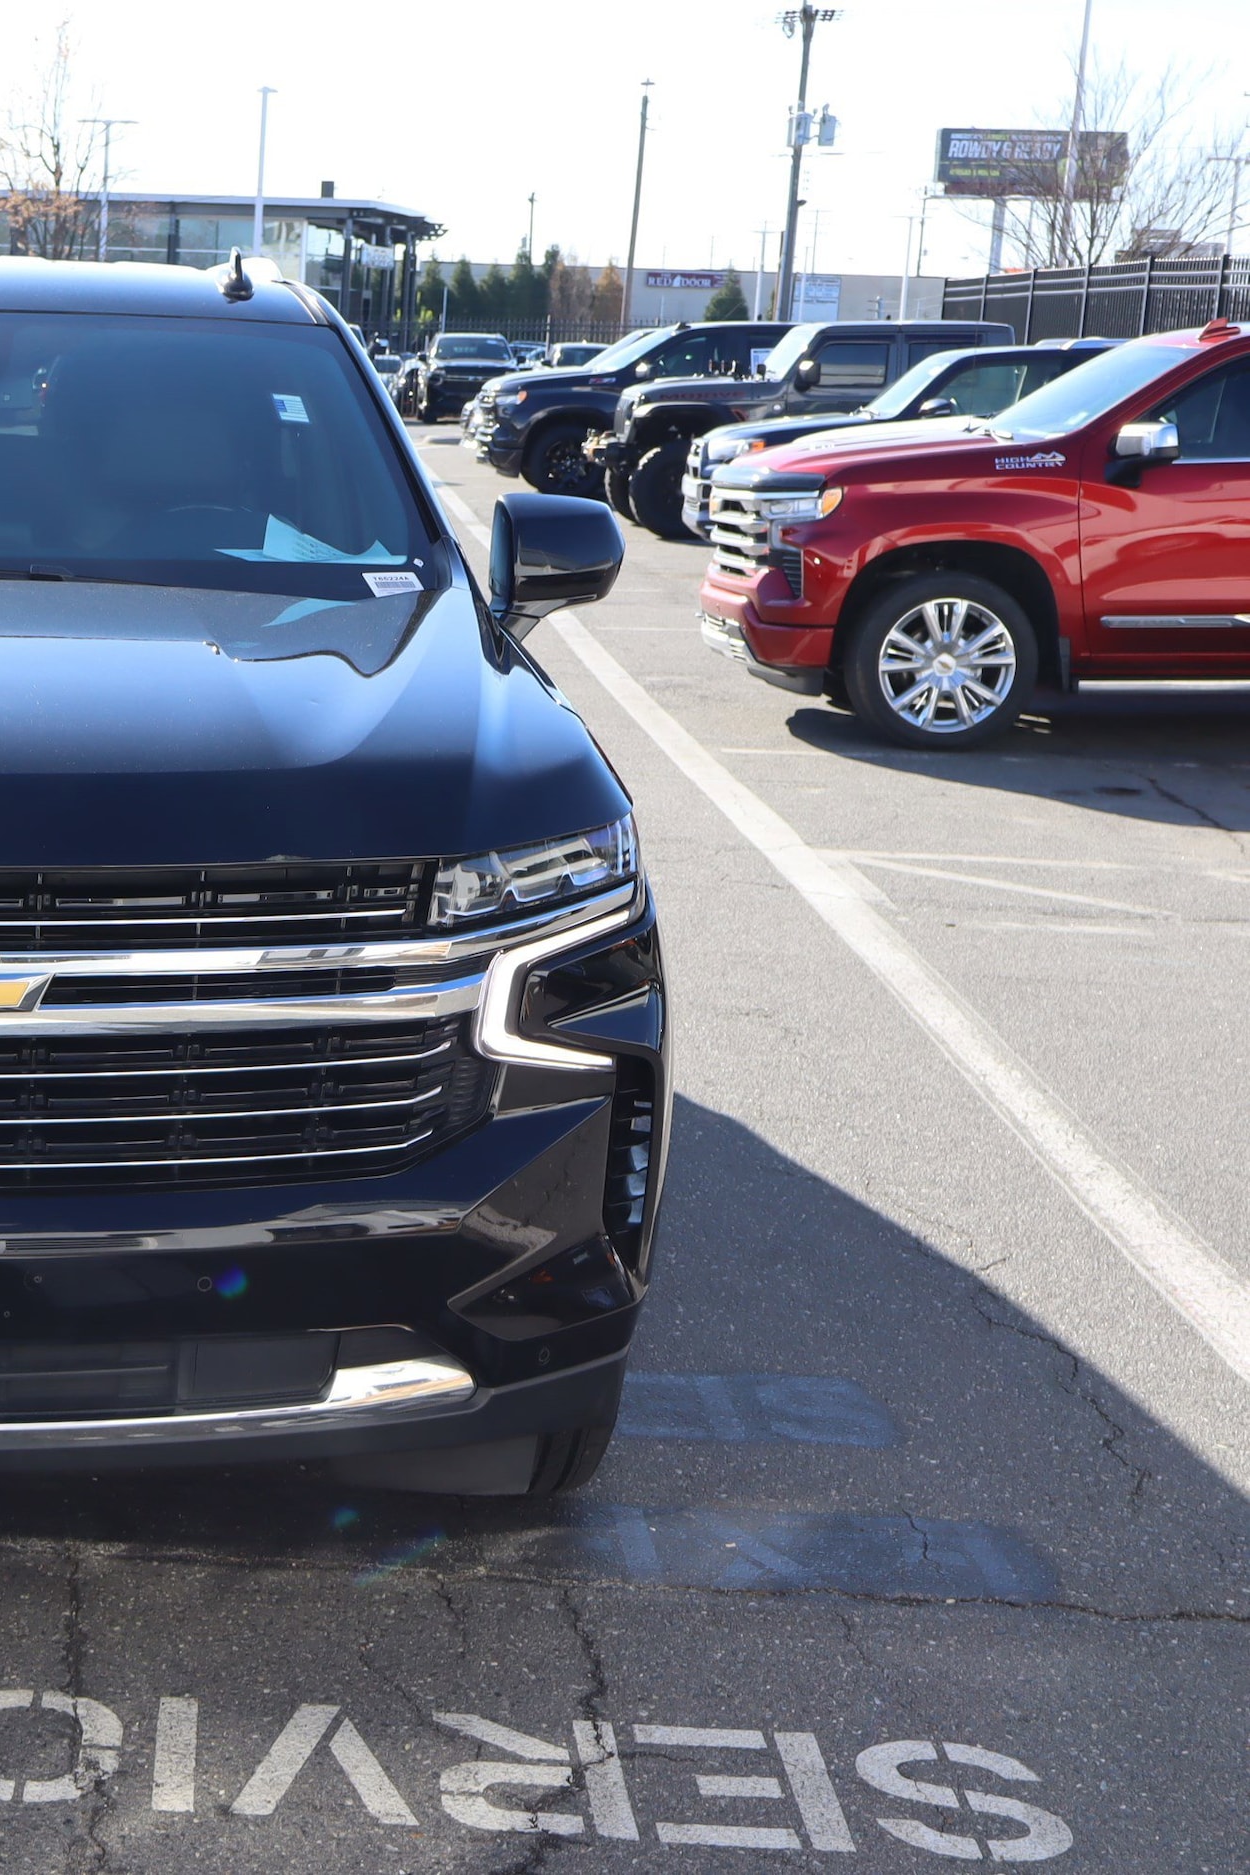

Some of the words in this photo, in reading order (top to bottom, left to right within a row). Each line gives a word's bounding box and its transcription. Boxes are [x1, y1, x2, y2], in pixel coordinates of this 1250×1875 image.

[948, 140, 1001, 159] ROWDY
[648, 277, 671, 286] RED
[681, 278, 711, 287] DOOR
[660, 391, 746, 400] MOJAVE
[994, 456, 1032, 464] HIGH
[995, 461, 1064, 470] COUNTRY
